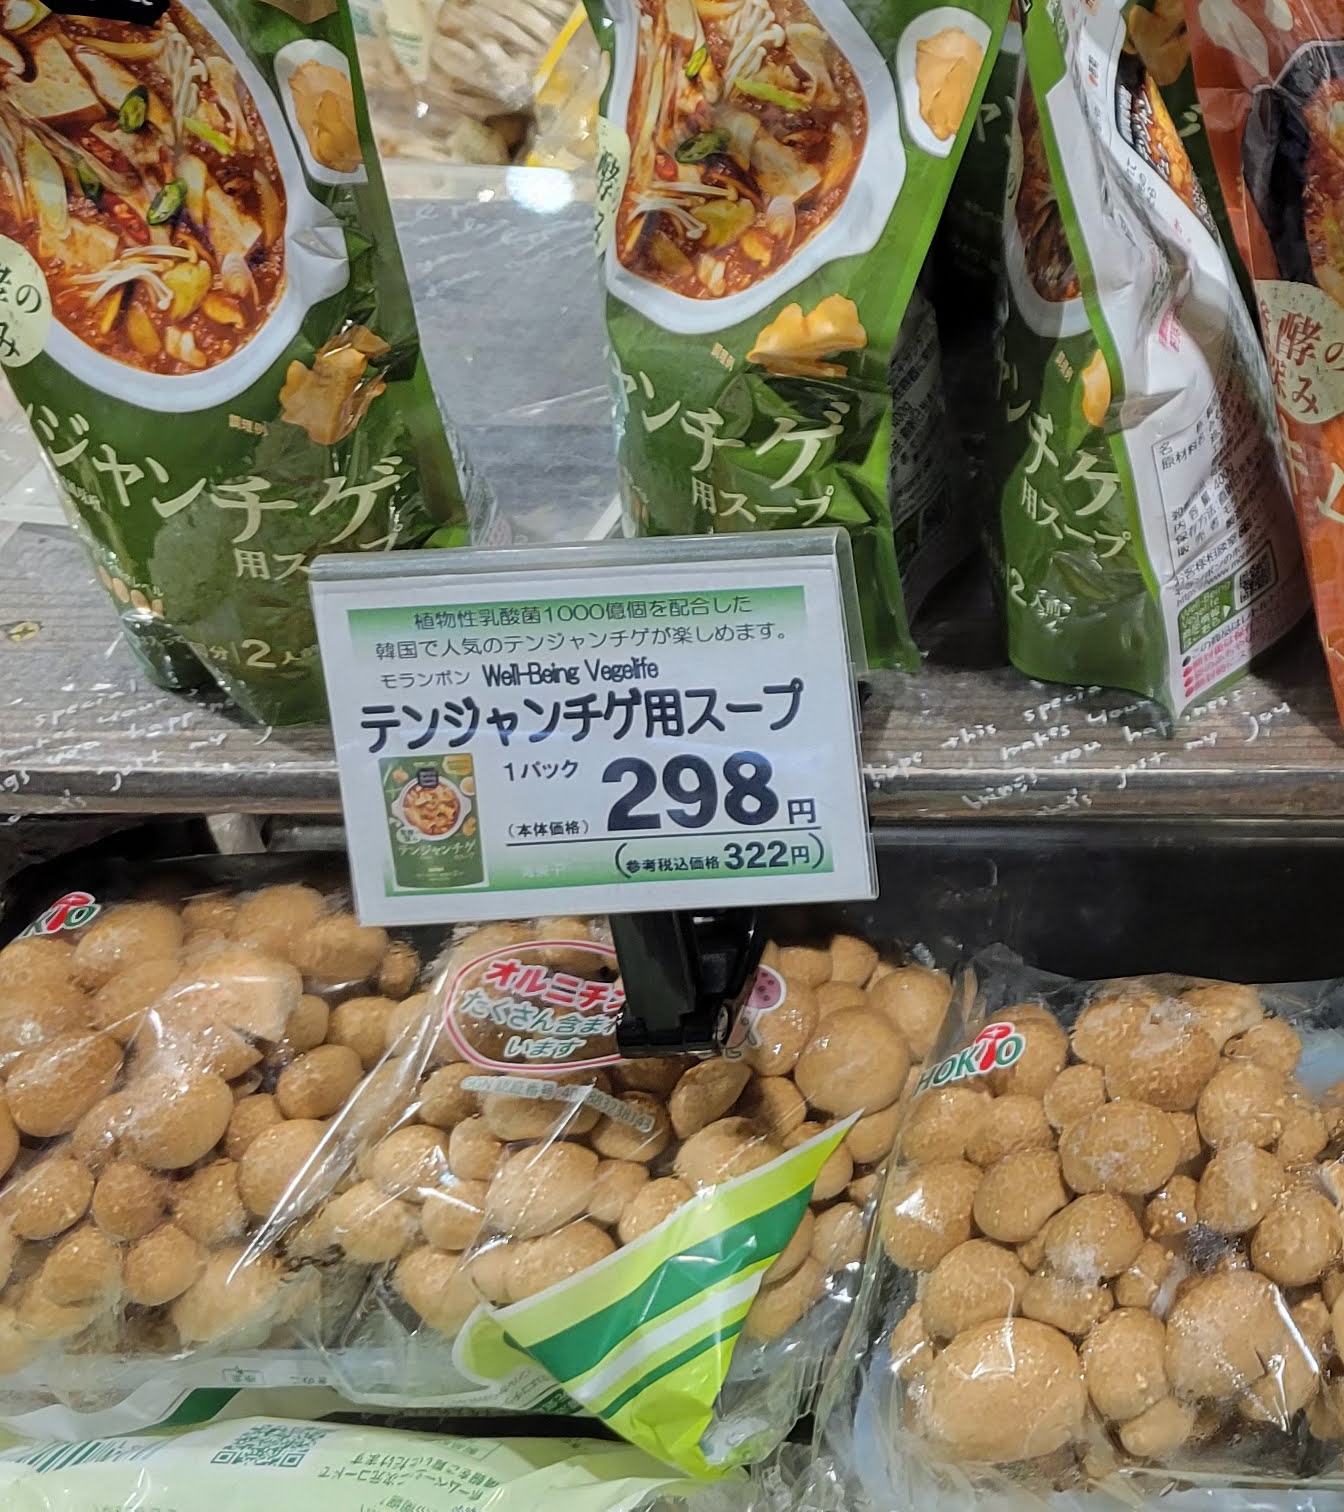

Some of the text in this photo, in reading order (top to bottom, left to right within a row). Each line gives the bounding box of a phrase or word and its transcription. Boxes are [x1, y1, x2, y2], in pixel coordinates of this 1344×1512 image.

[693, 476, 834, 526] 用スープ
[1021, 477, 1131, 558] 用スープ
[414, 594, 753, 630] 植物性乳酸菌1000億個を配合した
[375, 622, 788, 661] 韓国で人気のテンジャンチゲが楽しめます。
[380, 657, 659, 690] モランボン Well-Being Vegelife
[360, 678, 805, 754] テンジャンチゲ用スープ
[503, 759, 579, 783] 1パック
[505, 1036, 586, 1060] います
